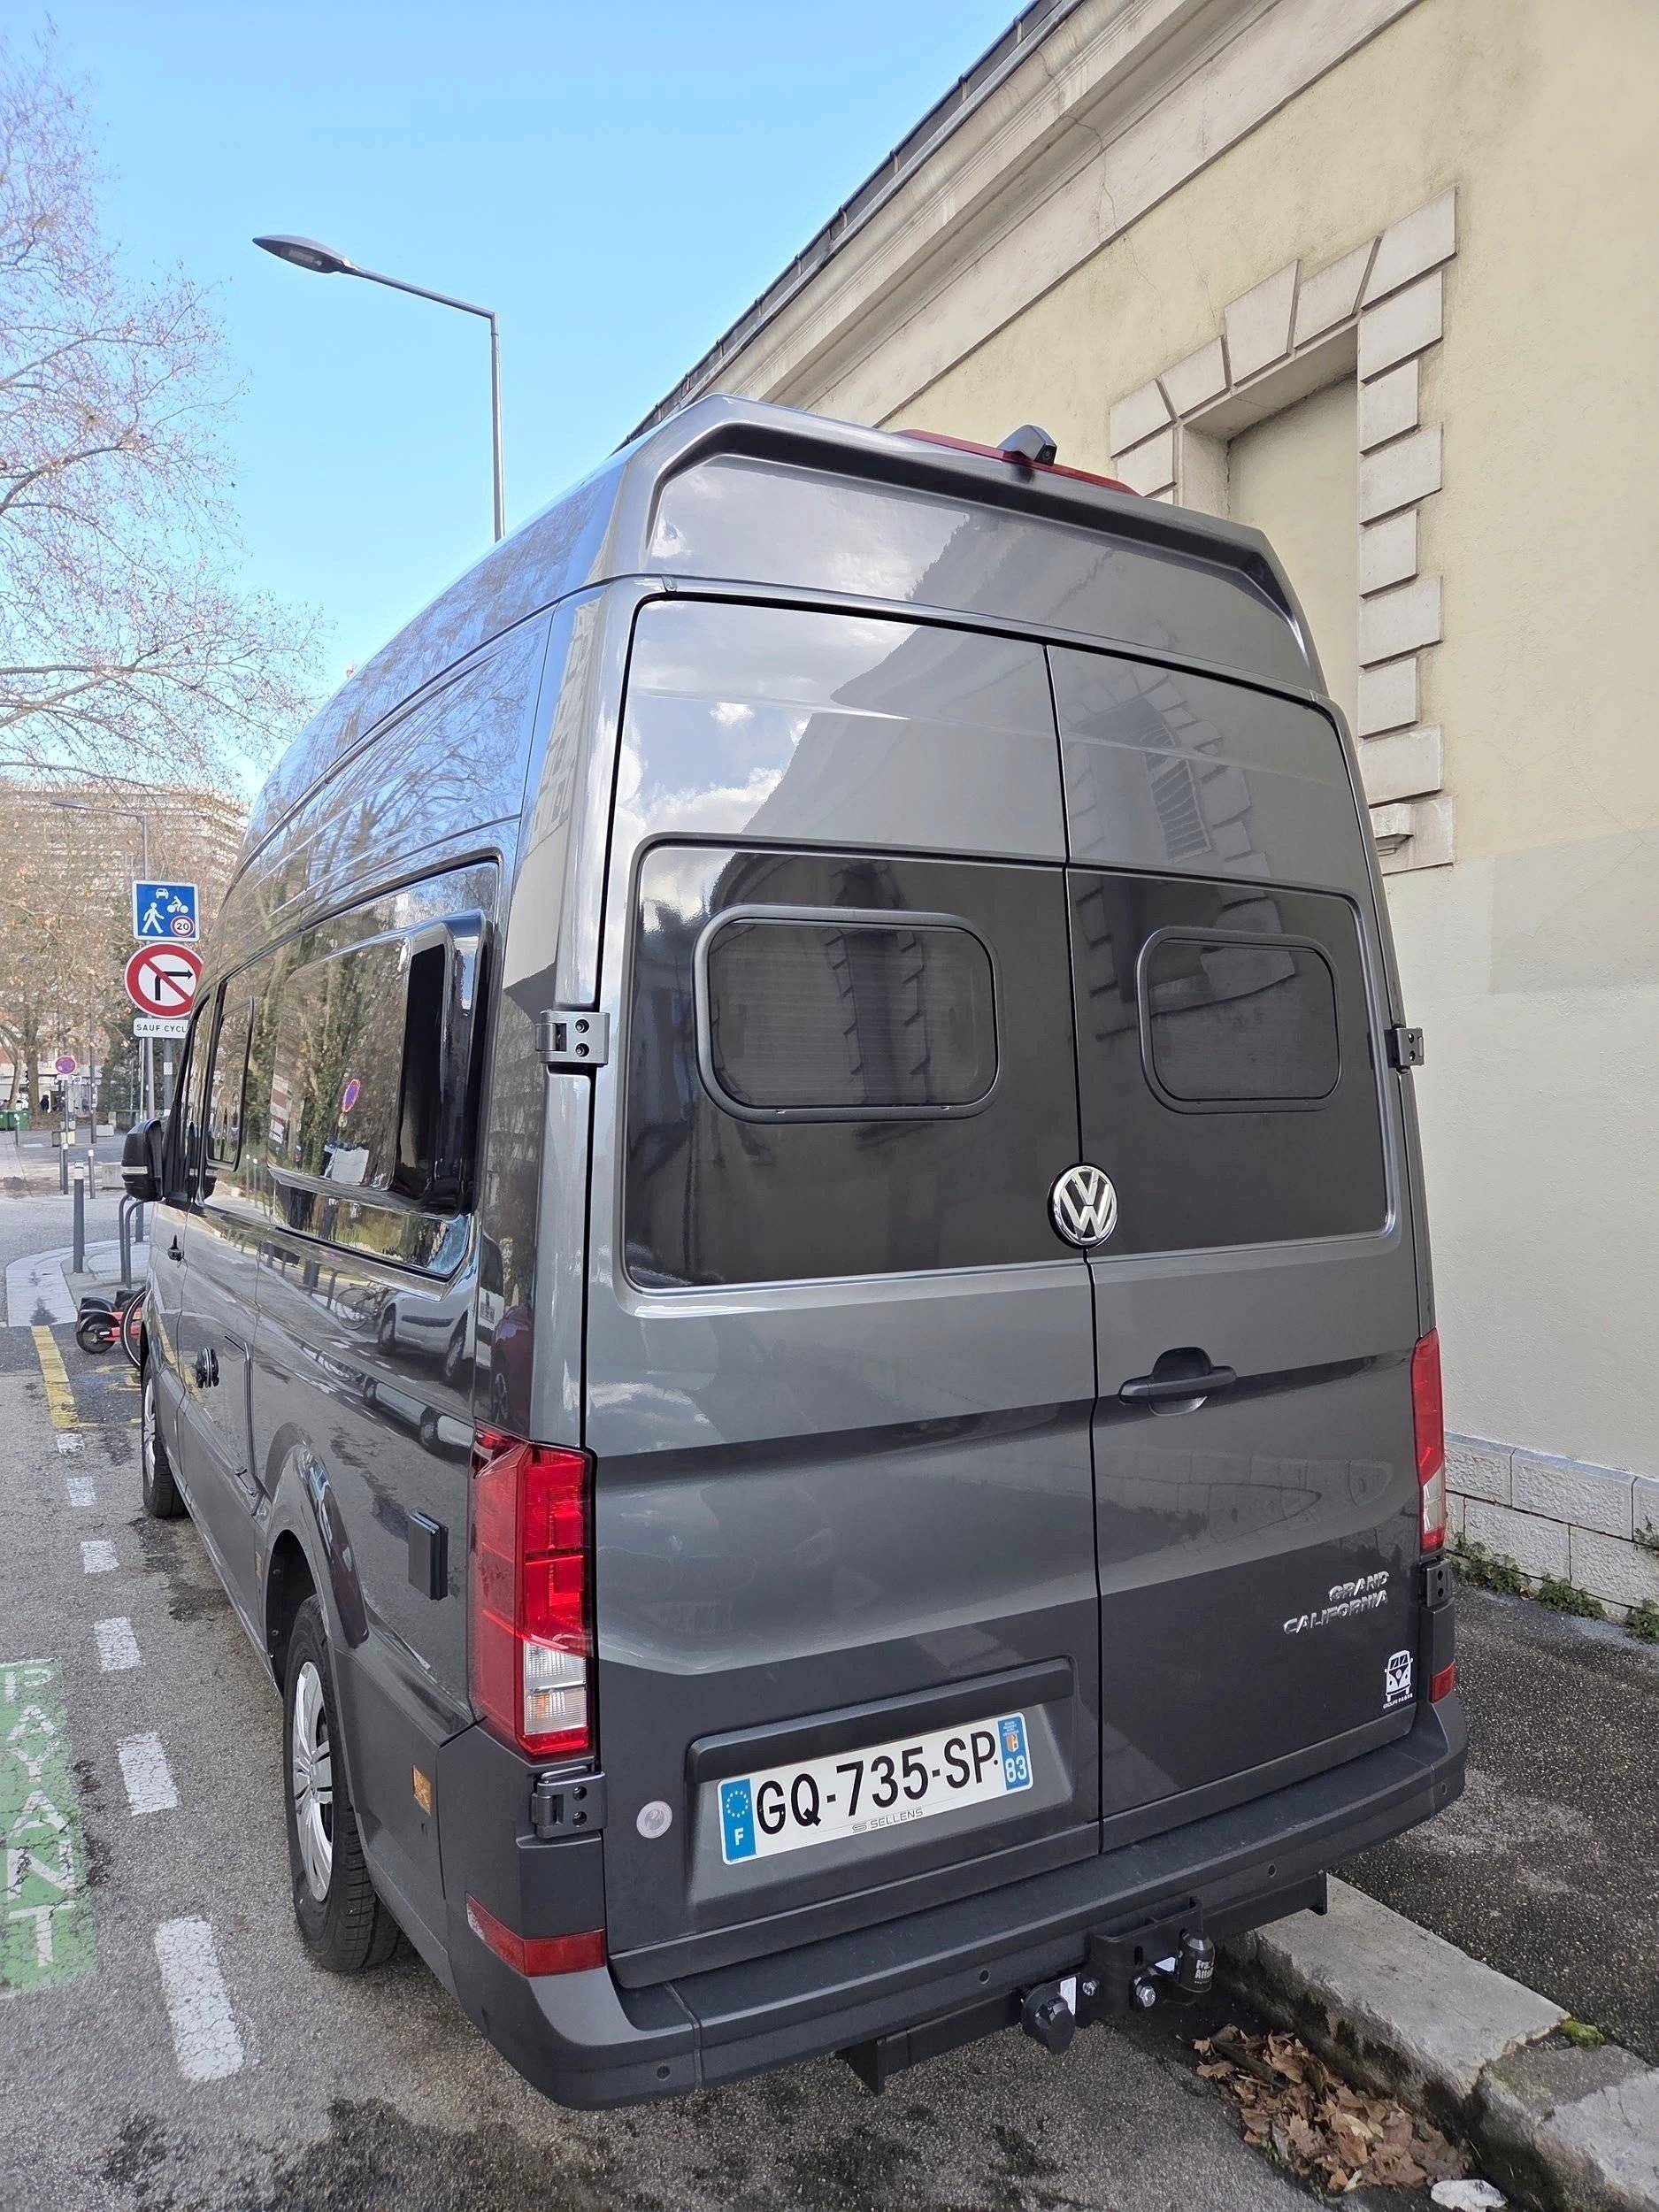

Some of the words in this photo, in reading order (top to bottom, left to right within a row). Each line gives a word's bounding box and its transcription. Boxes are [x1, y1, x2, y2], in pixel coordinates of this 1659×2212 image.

[177, 922, 189, 931] 20
[164, 1025, 188, 1033] CYCL
[1058, 1168, 1113, 1241] VW
[1329, 1571, 1390, 1601] GRAND
[1283, 1590, 1388, 1634] CALIFORNIA
[1004, 1755, 1027, 1783] 83
[756, 1731, 997, 1836] GQ-735-SP
[870, 1808, 924, 1829] SELLENS
[733, 1826, 745, 1847] F
